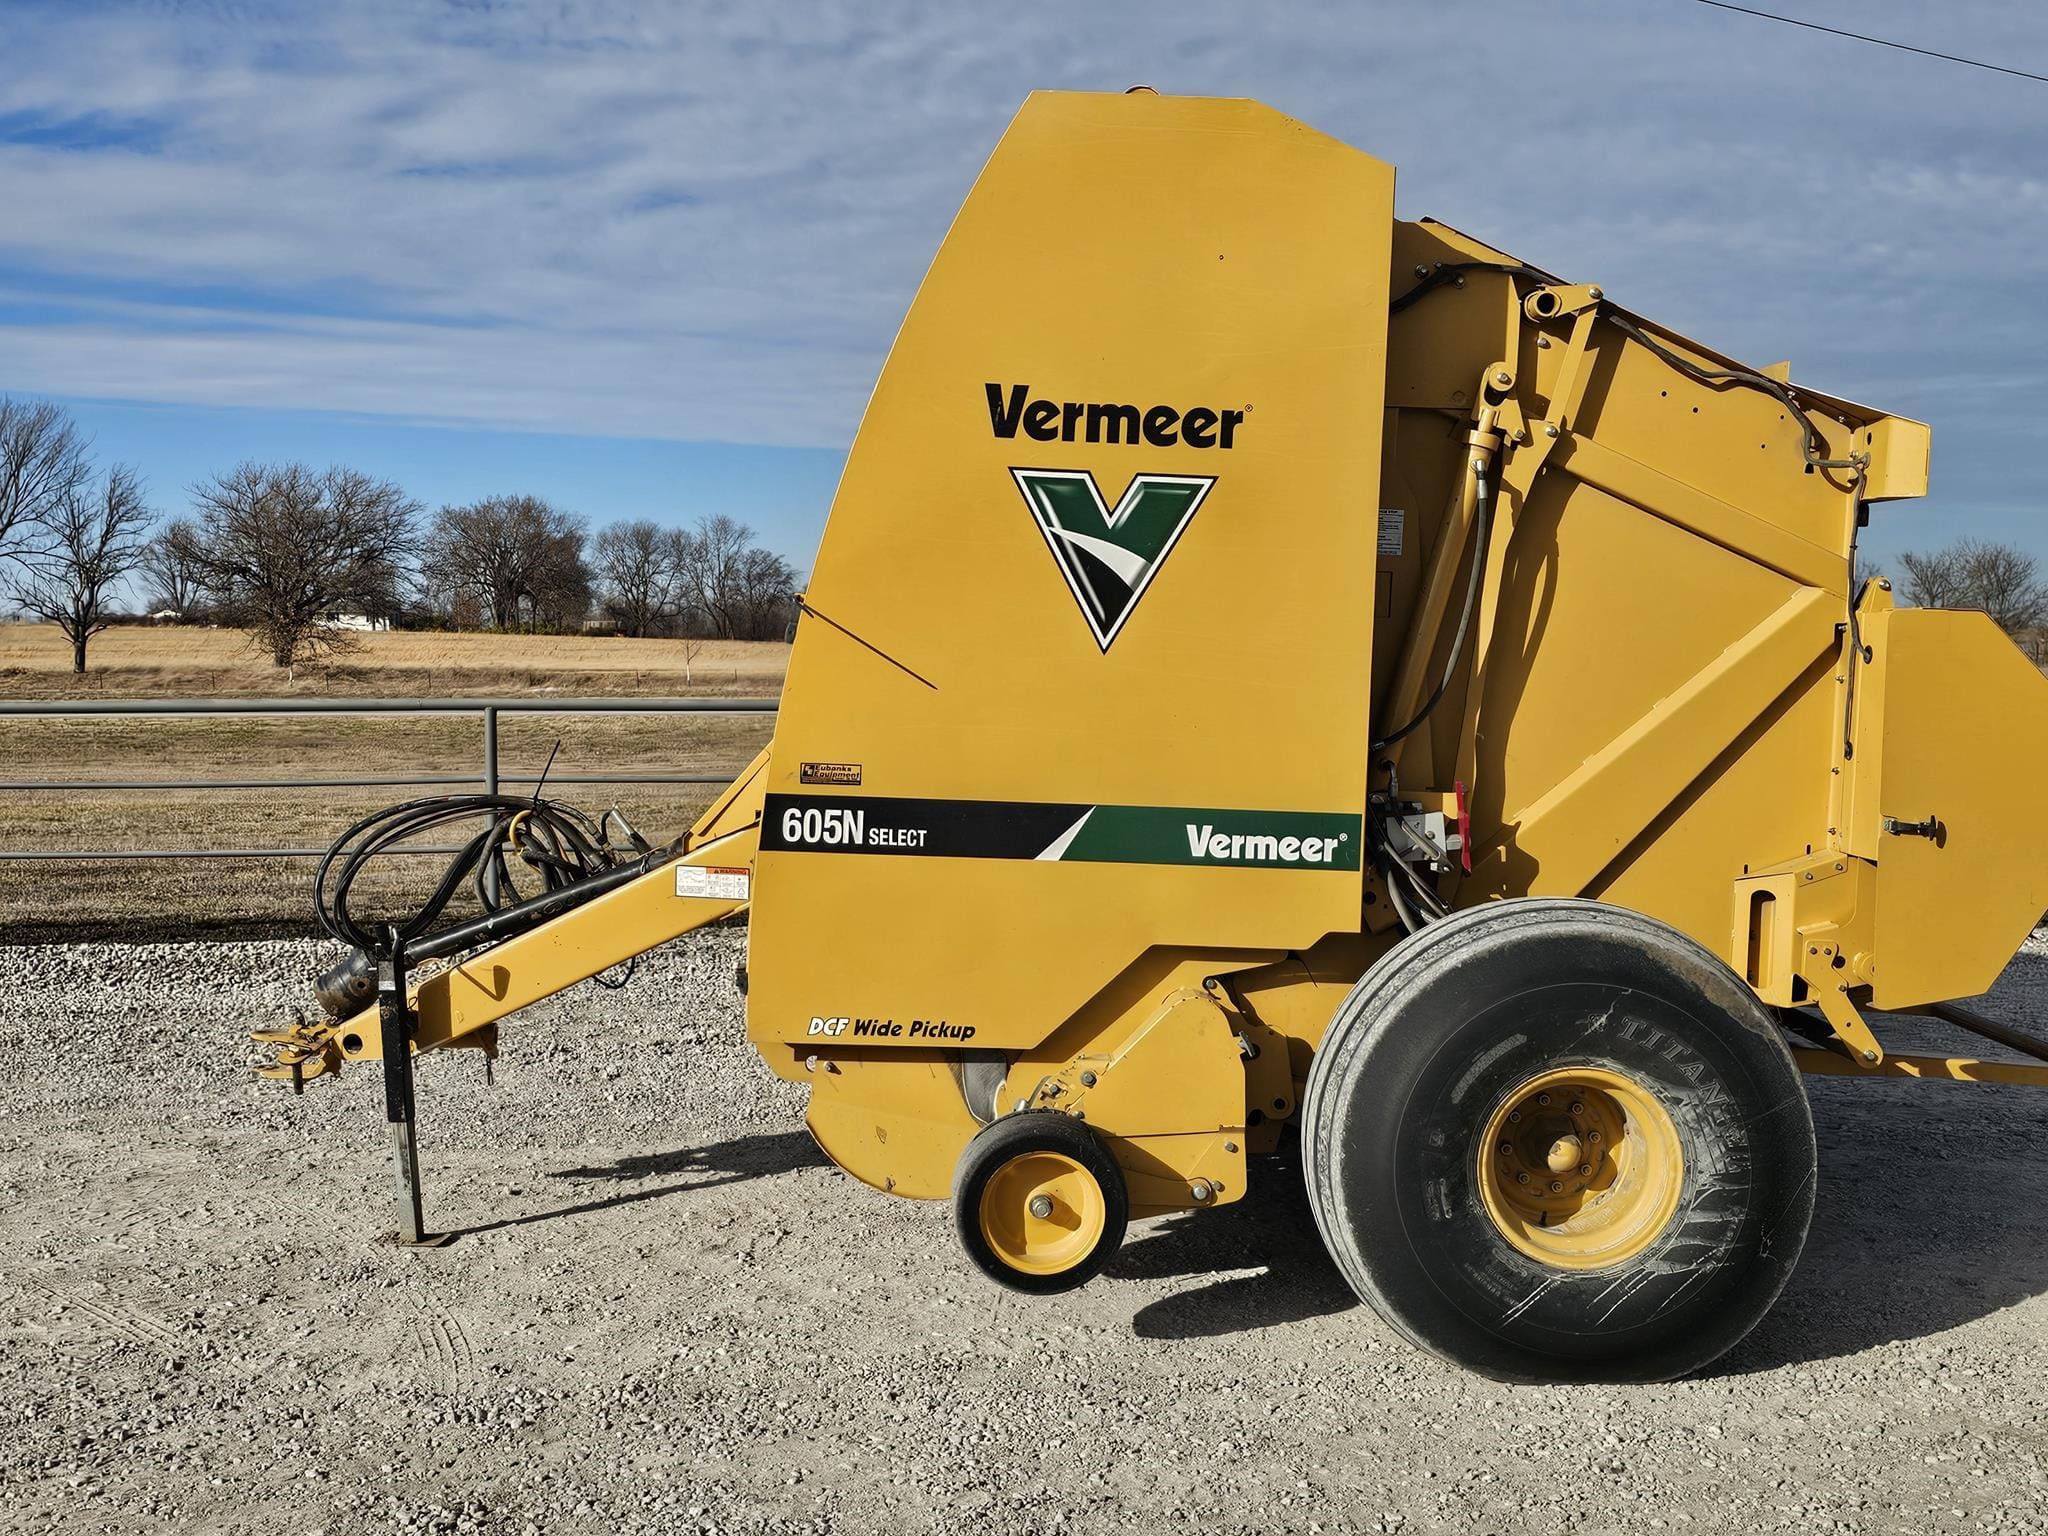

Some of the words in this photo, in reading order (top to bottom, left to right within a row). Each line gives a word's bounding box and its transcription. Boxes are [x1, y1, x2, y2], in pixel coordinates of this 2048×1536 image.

[985, 383, 1243, 449] Vermeer
[814, 771, 860, 780] Equipment
[815, 764, 852, 772] Eubanks
[782, 807, 865, 845] 605N
[868, 828, 928, 847] SELECT
[1186, 824, 1338, 863] Vermeer
[807, 1016, 850, 1037] DCF
[853, 1018, 903, 1037] Wide
[908, 1020, 976, 1042] Pickup
[1617, 1015, 1731, 1108] TITAN
